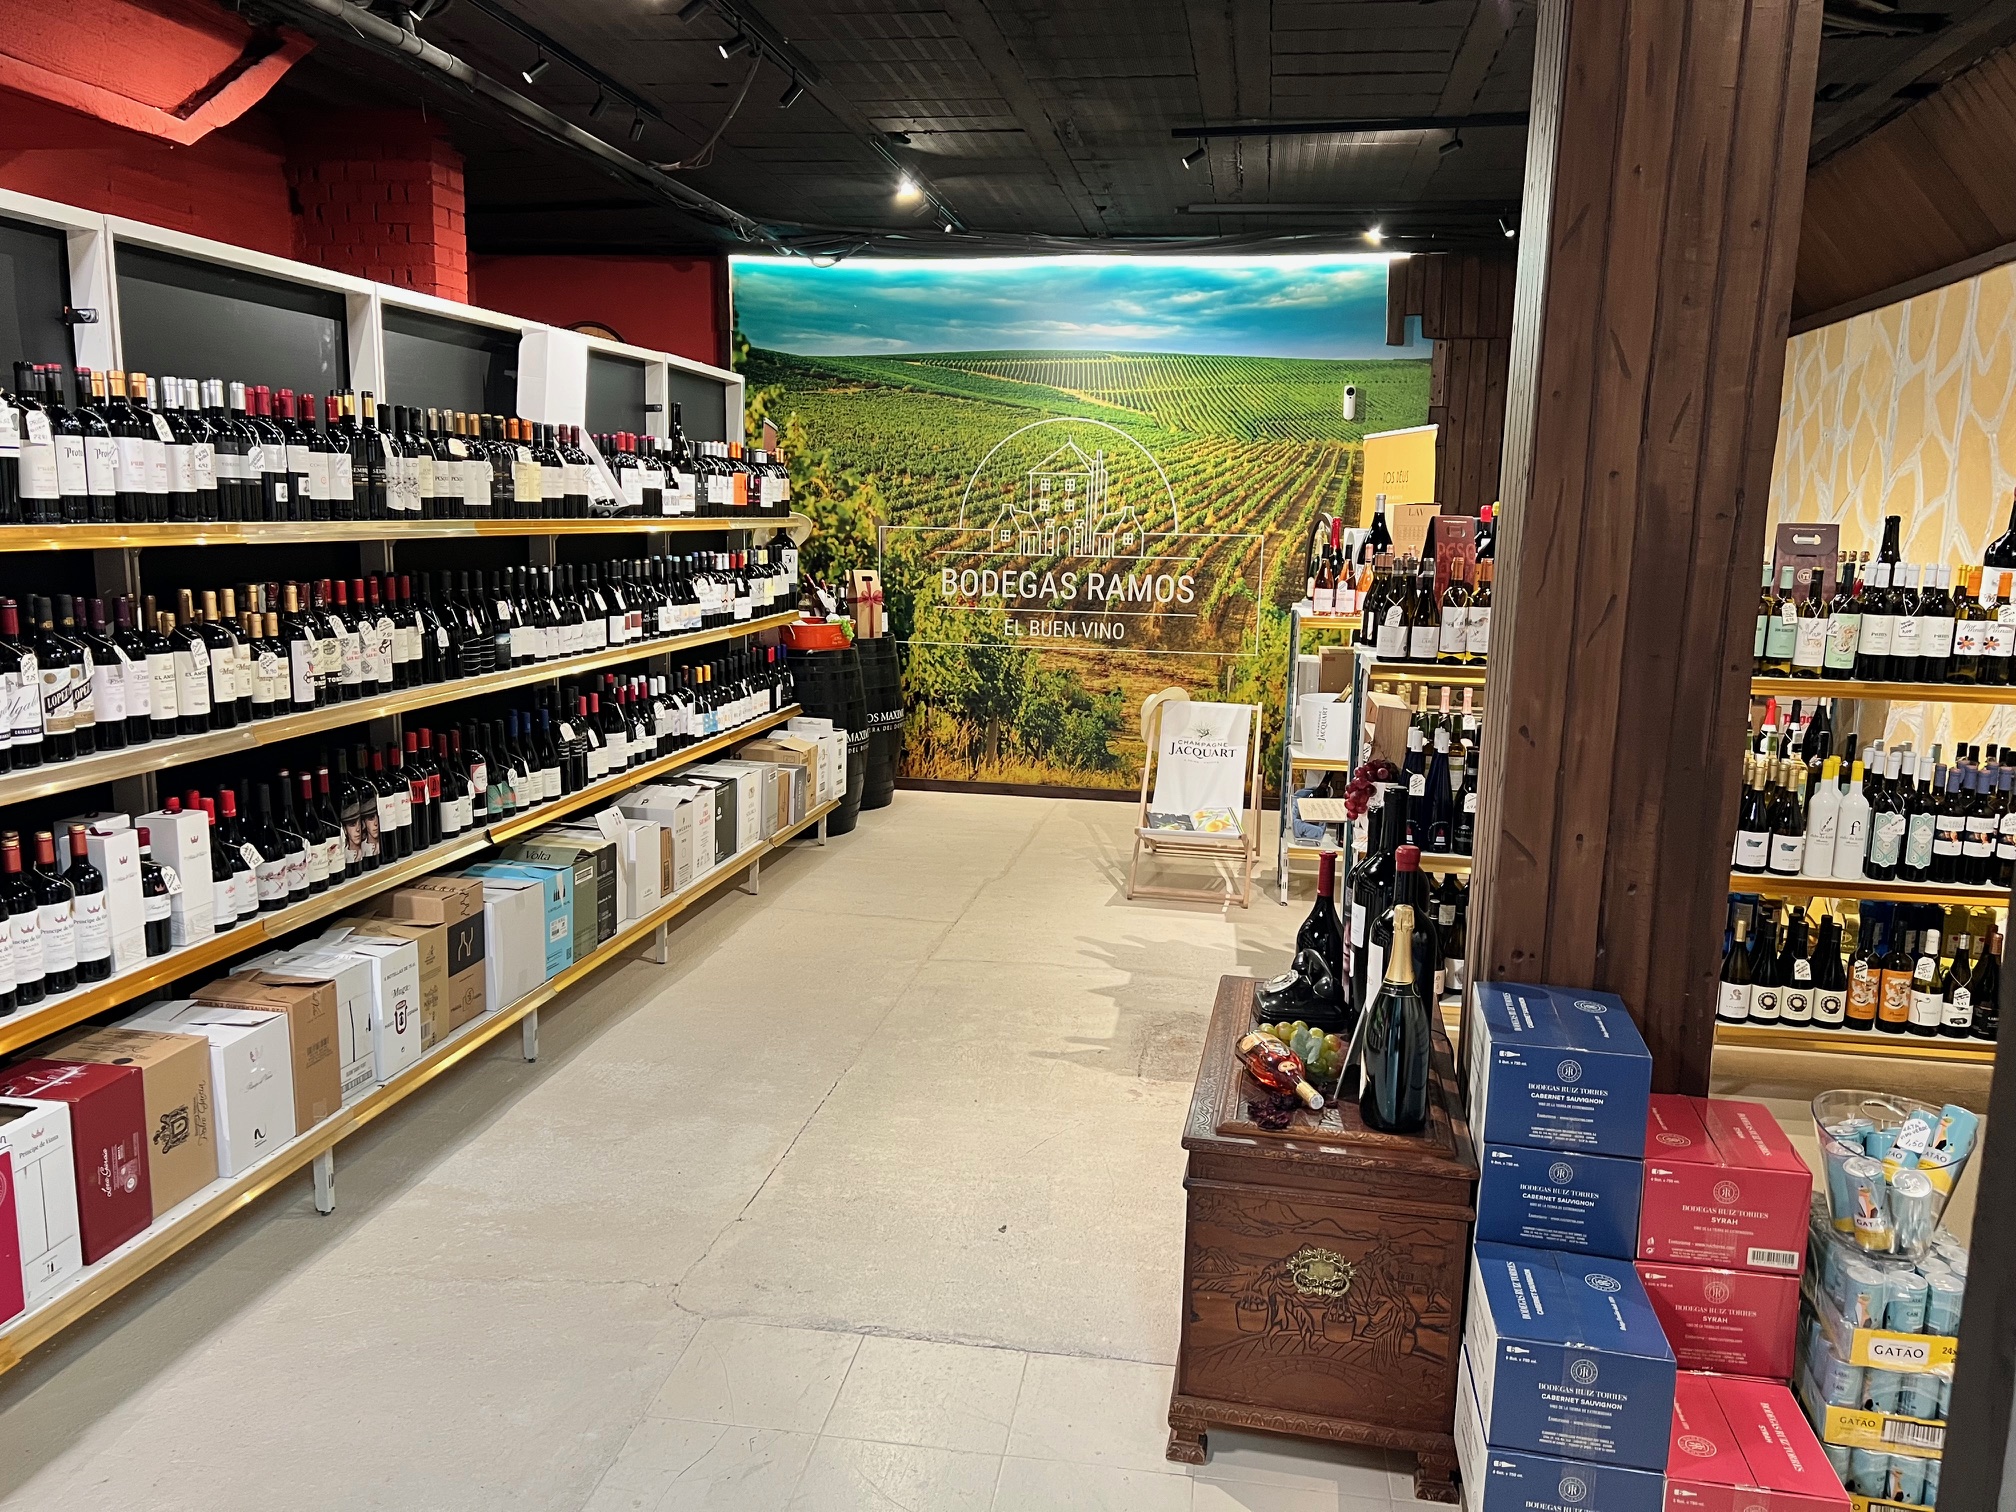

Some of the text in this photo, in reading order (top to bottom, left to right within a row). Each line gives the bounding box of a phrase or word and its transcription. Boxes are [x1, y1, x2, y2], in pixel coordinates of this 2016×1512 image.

[942, 568, 1196, 604] BODEGAS RAMOS
[1004, 618, 1125, 640] EL BUEN VINO
[1168, 741, 1237, 759] JACQUART
[1178, 739, 1228, 748] CHAMPAGNE
[525, 850, 551, 861] Volta
[1528, 1083, 1608, 1096] BODEGAS RUIZ TORRES
[1530, 1092, 1604, 1105] CABERNET SAUVIGNON
[1520, 1184, 1600, 1199] BODEGAS RUIZ TORRES
[1522, 1192, 1594, 1207] CABERNET SAUVIGNON
[1682, 1204, 1768, 1219] BODEGAS RUIZ TORRES
[1711, 1216, 1738, 1226] SYRAH
[1675, 1304, 1757, 1317] BODEGAS RUIZ TORRES
[1702, 1316, 1728, 1324] SYRAH
[1874, 1345, 1924, 1358] GATÃO
[1538, 1382, 1628, 1401] BODEGAS RUIZ TORRES
[1542, 1393, 1622, 1410] CABERNET SAUVIGNON
[1840, 1416, 1876, 1428] GATÃO
